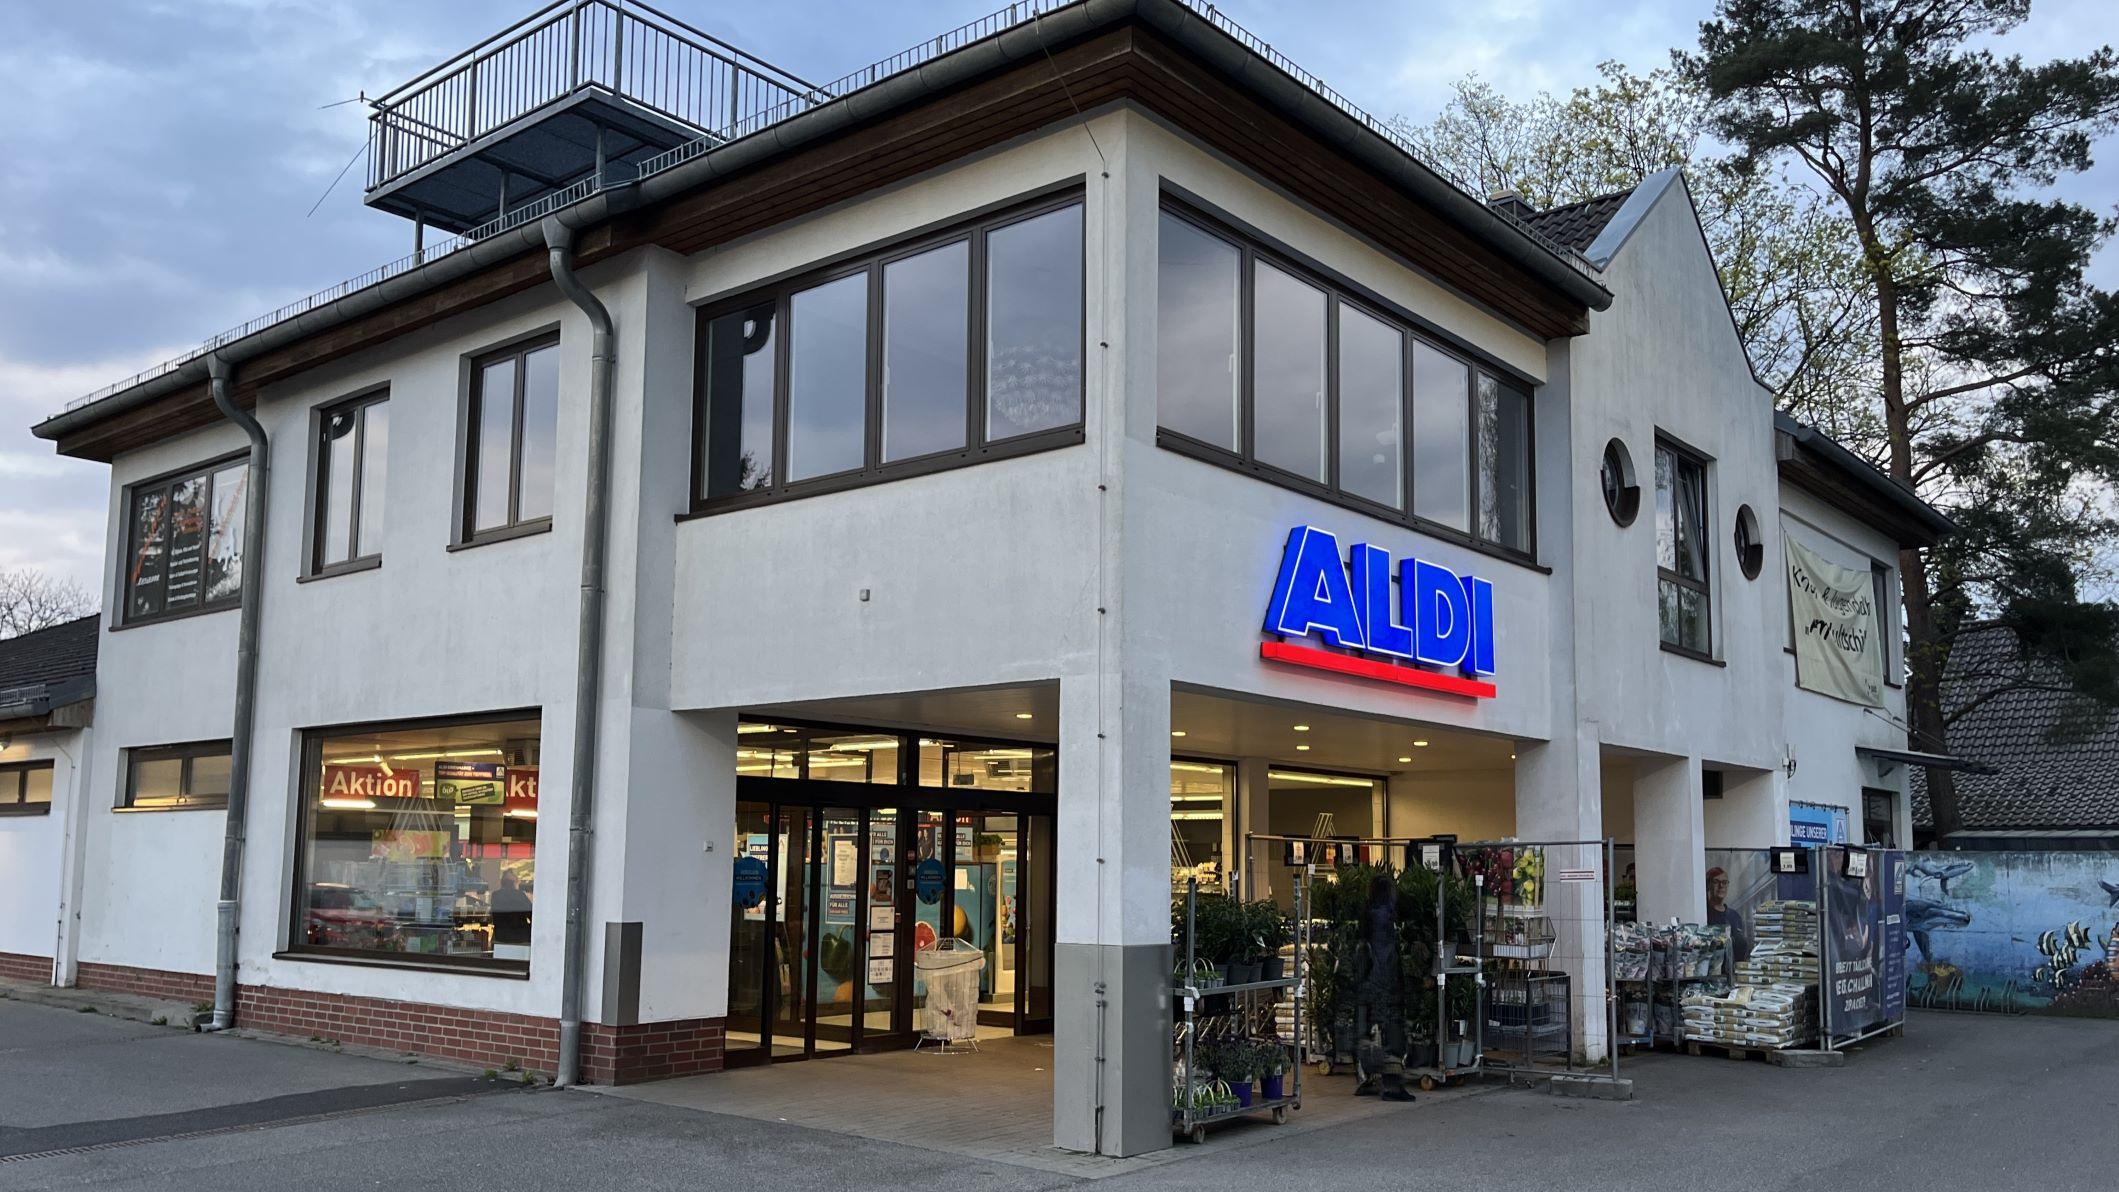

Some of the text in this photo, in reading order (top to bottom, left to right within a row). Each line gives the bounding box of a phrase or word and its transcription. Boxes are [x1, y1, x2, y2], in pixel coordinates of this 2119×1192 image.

[1263, 525, 1496, 676] ALDI
[330, 770, 412, 798] Aktion
[506, 774, 537, 798] kt
